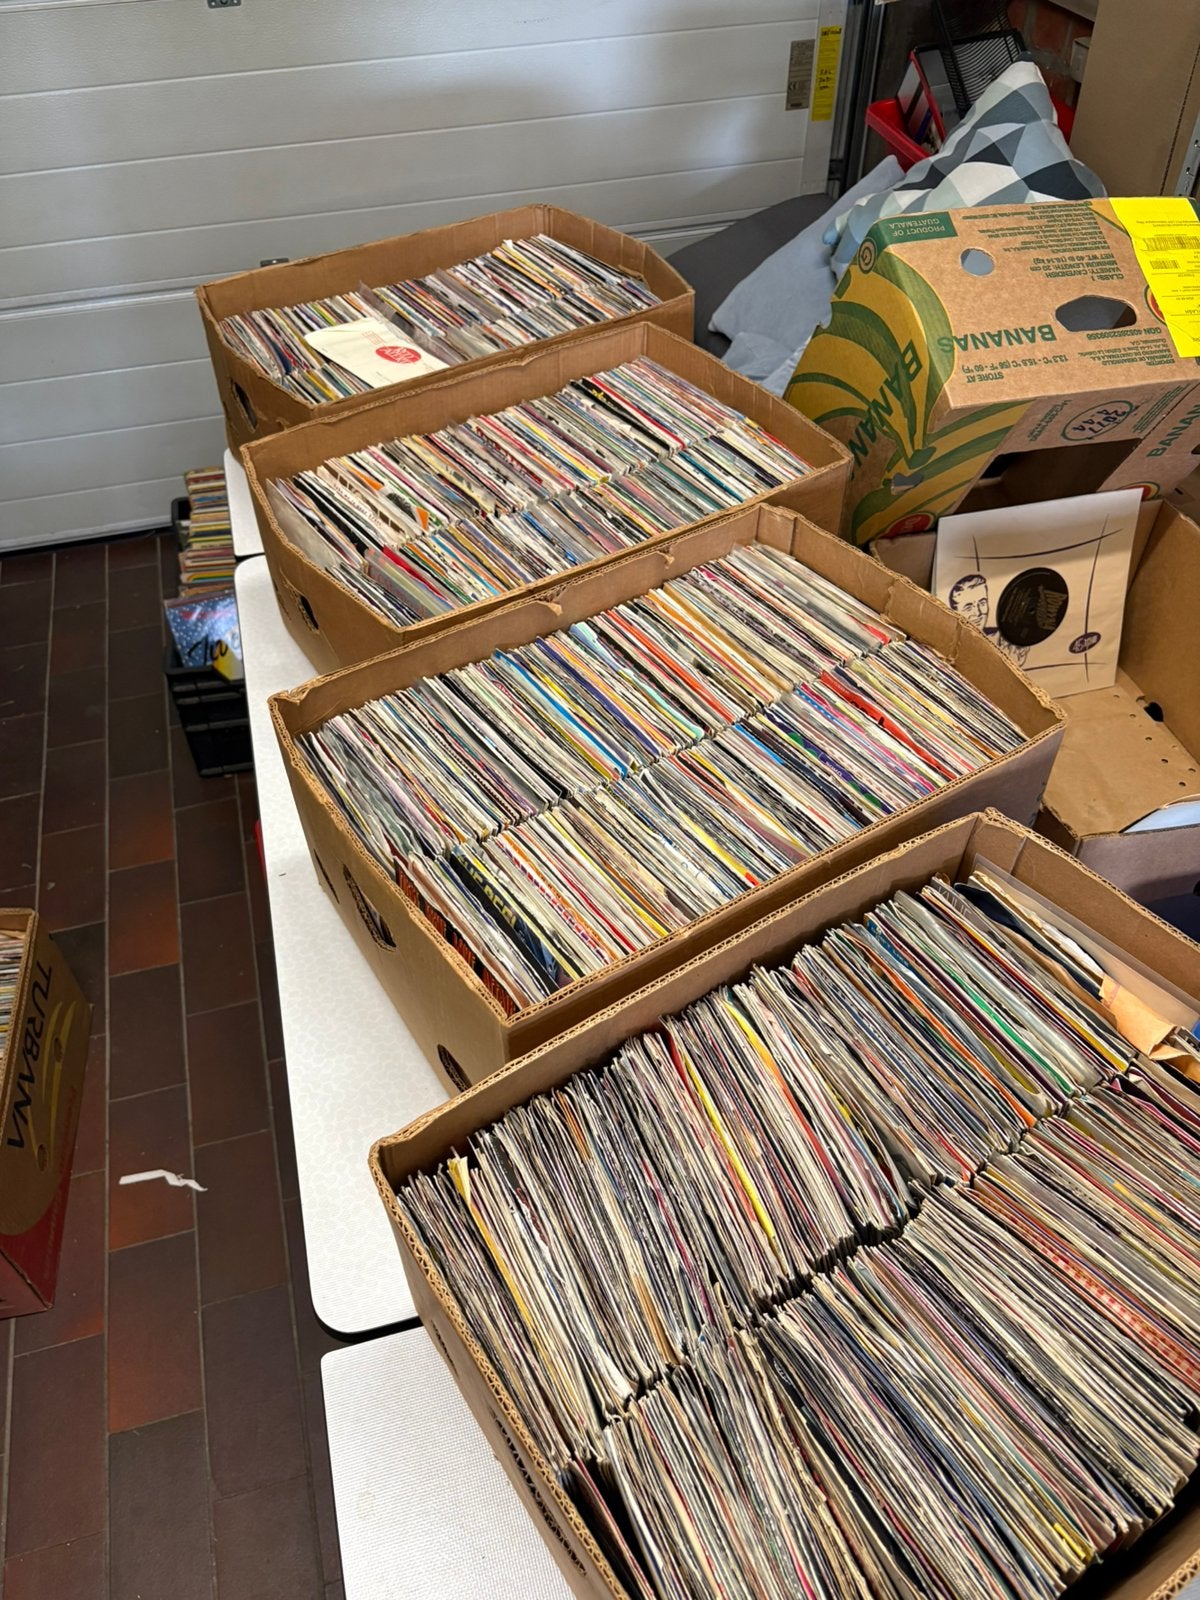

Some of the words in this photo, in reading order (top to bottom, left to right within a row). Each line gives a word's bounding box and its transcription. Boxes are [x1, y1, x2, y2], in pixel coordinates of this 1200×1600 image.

[889, 218, 939, 229] GUATEMALA
[906, 225, 945, 235] PRODUCT
[1045, 270, 1087, 278] CAVENDISH
[937, 324, 1056, 354] BANANAS
[1052, 354, 1068, 363] 13.3
[974, 364, 984, 372] 60
[978, 372, 1004, 382] STORE
[6, 959, 52, 1149] TURBANA
